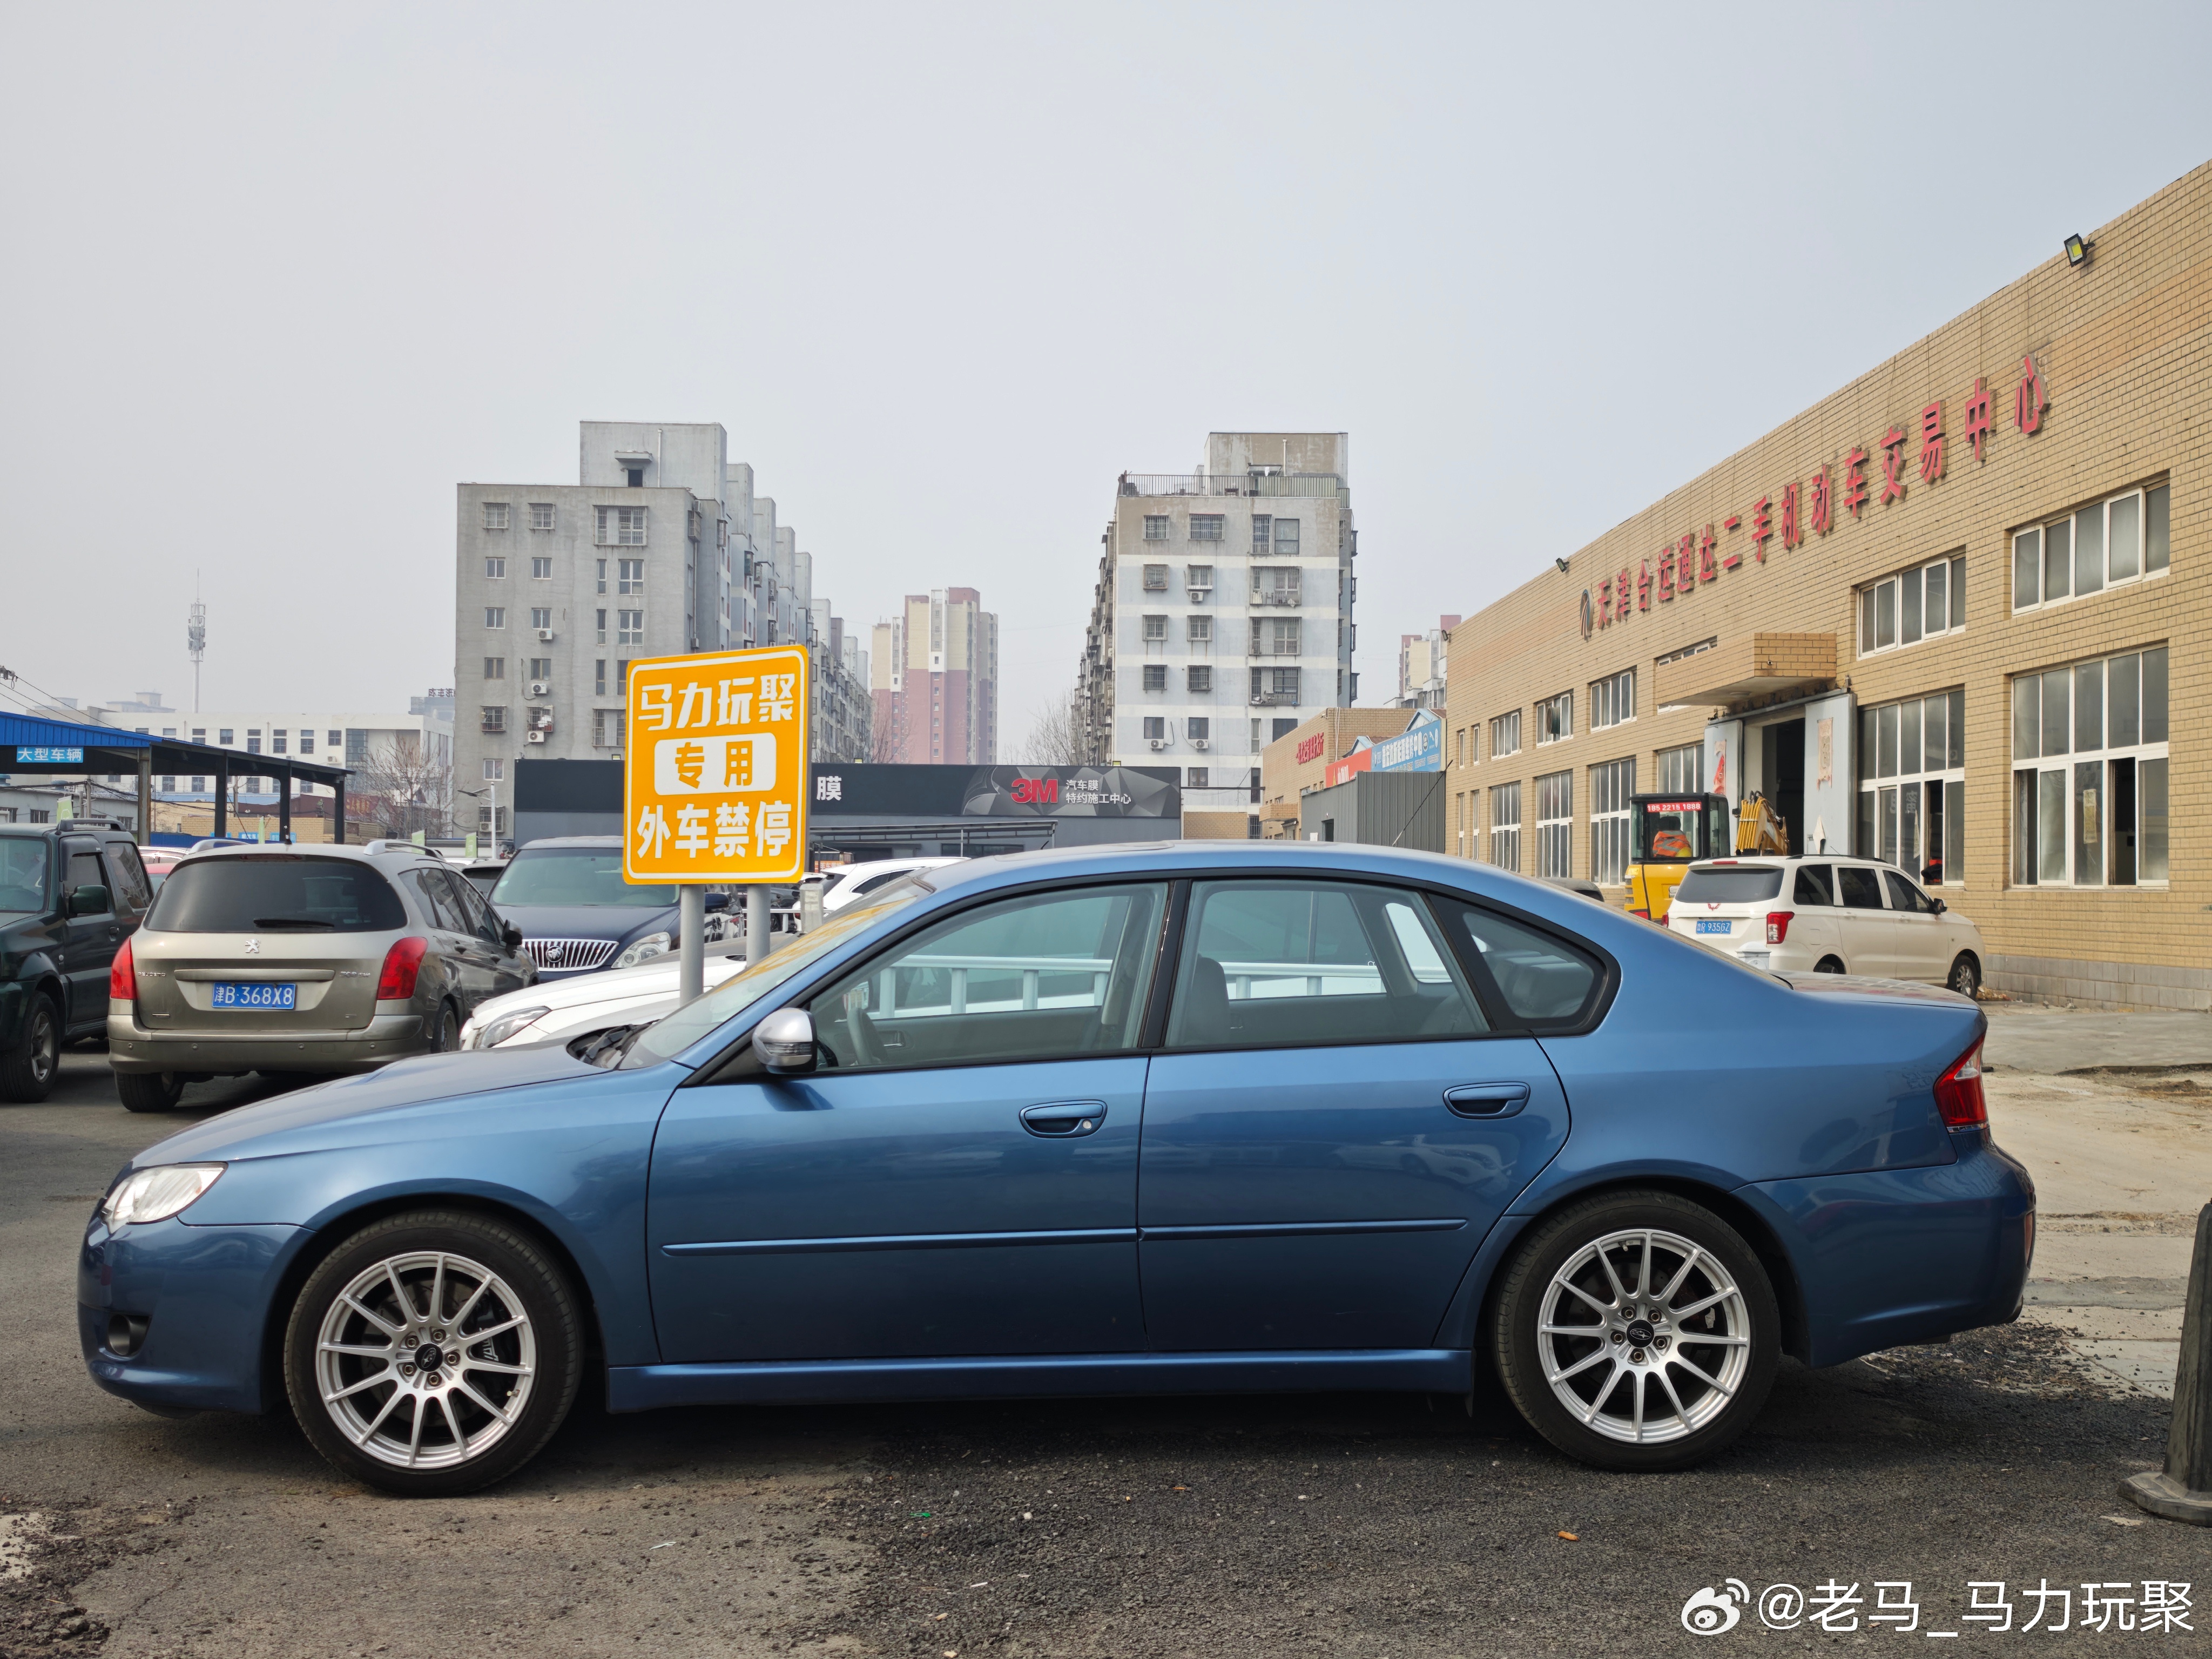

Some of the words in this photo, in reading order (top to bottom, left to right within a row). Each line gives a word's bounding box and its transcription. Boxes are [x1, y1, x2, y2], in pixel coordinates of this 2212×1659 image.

[1597, 353, 2050, 629] 天津合运通达二手机动车交易中心
[638, 673, 795, 731] 马力玩聚
[18, 747, 82, 761] 大型车辆
[675, 740, 753, 789] 专用
[817, 776, 842, 801] 膜
[1010, 778, 1058, 804] 3M
[1066, 779, 1098, 791] 汽车膜
[1066, 792, 1131, 804] 特约施工中心
[637, 800, 792, 859] 外车禁停
